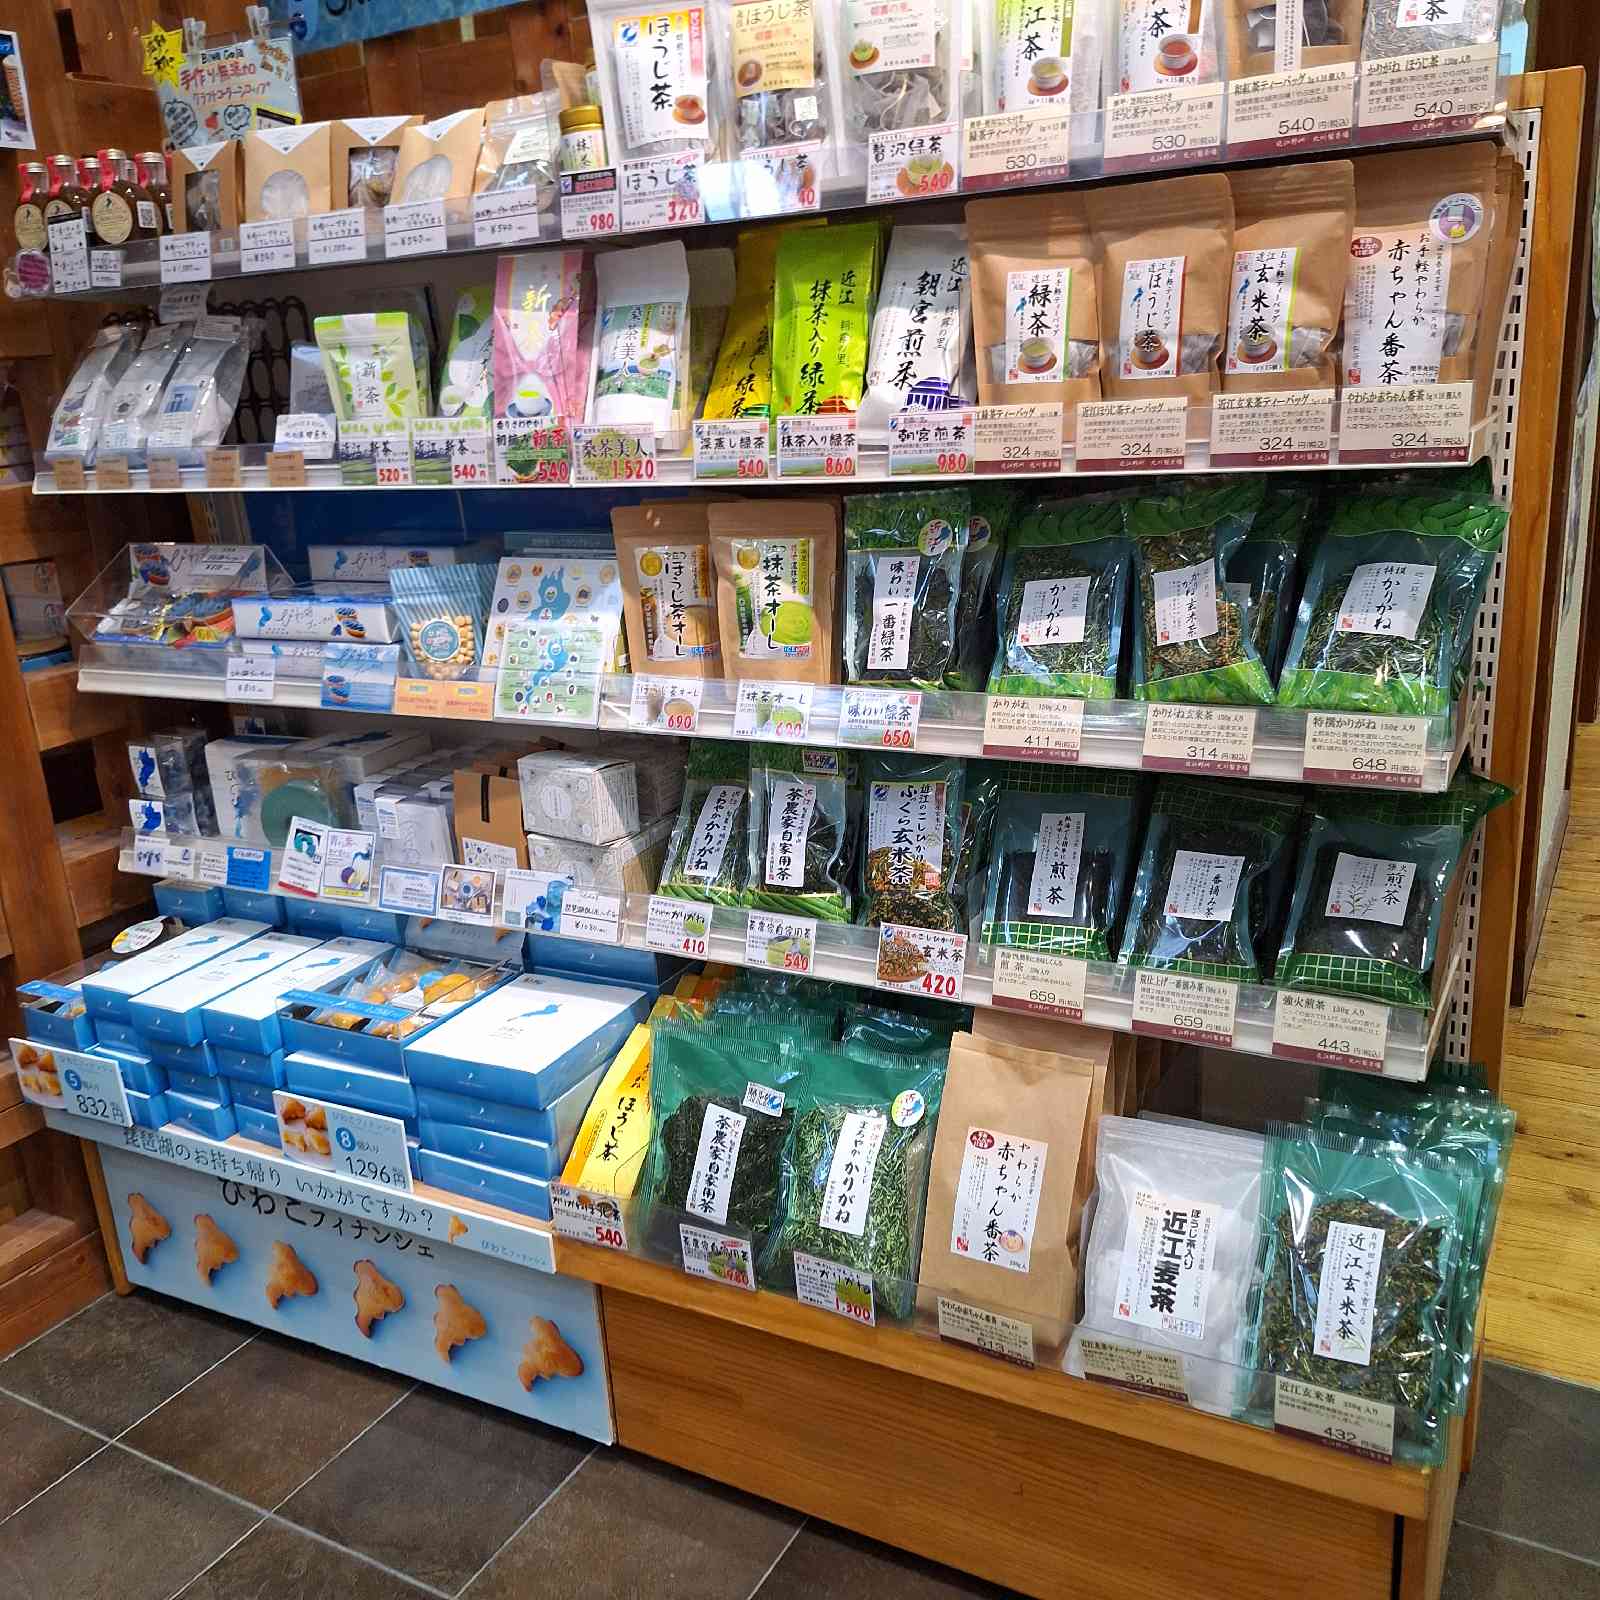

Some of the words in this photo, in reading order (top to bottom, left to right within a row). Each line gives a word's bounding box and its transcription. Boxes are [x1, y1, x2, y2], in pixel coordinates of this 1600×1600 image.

[648, 17, 673, 111] ほうじ茶
[1414, 99, 1453, 118] 540
[1278, 116, 1315, 135] 540
[872, 136, 943, 164] 贅沢緑茶
[1151, 134, 1186, 151] 530
[1006, 153, 1036, 170] 530
[626, 164, 697, 191] ほうじ茶
[919, 172, 950, 192] 540
[590, 212, 615, 231] 980
[667, 200, 699, 223] 320
[947, 256, 969, 293] 近江
[1411, 233, 1431, 326] お手軽やわらか
[838, 270, 857, 305] 近江
[1027, 284, 1053, 338] 緑茶
[1145, 272, 1163, 353] ほうじ茶
[1247, 263, 1274, 341] 玄米茶
[1377, 239, 1412, 385] 赤ちゃん番茶
[887, 271, 942, 390] 朝宮煎茶
[797, 280, 832, 415] 抹茶入り緑茶
[360, 360, 380, 405] 新茶
[532, 428, 567, 449] 新茶
[700, 436, 766, 450] 深蒸し緑茶
[781, 432, 857, 449] 抹茶入り緑茶
[898, 426, 967, 442] 朝宮煎茶
[1260, 436, 1294, 451] 324
[1391, 433, 1427, 448] 324
[582, 438, 649, 458] 桑茶美人
[1002, 445, 1031, 459] 324
[1120, 442, 1152, 457] 324
[454, 464, 477, 480] 540
[537, 460, 569, 482] 540
[737, 458, 765, 476] 540
[823, 455, 856, 476] 860
[936, 453, 967, 473] 980
[378, 468, 400, 482] 520
[880, 560, 905, 663] 味わい一番緑茶
[1045, 583, 1067, 640] かりがね
[1374, 577, 1401, 631] かりがね
[847, 703, 913, 722] 味わい緑茶
[992, 699, 1030, 710] かりがね
[1152, 708, 1214, 721] かりがね玄米茶
[667, 714, 693, 730] 690
[882, 728, 911, 747] 650
[1024, 734, 1051, 748] 411
[1186, 745, 1218, 759] 314
[1352, 756, 1388, 771] 648
[694, 789, 727, 871] さわやかかりがね
[775, 787, 804, 883] 茶農家自家用茶
[1046, 860, 1068, 905] 煎茶
[1205, 865, 1225, 918] 一番摘み茶
[1382, 872, 1406, 906] 煎茶
[682, 937, 706, 954] 410
[923, 944, 965, 963] 玄米茶
[784, 951, 810, 973] 540
[922, 973, 956, 996] 420
[1029, 989, 1056, 1004] 659
[1173, 1014, 1204, 1029] 659
[1318, 1038, 1351, 1054] 443
[77, 1094, 111, 1118] 832
[111, 1102, 126, 1124] 円
[340, 1130, 353, 1149] 8
[596, 1096, 637, 1162] ほうじ茶
[698, 1113, 734, 1214] 茶農家自家用茶
[835, 1120, 865, 1225] まろやかかりがね
[1011, 1142, 1031, 1204] やわらか
[122, 1127, 282, 1188] 琵琶湖のお持ち帰り
[295, 1175, 434, 1233] いかがですか?
[982, 1141, 1016, 1263] 赤ちゃん番茶
[595, 1226, 623, 1247] 540
[1184, 1208, 1201, 1270] ほうじ茶入り
[1150, 1209, 1188, 1314] 近江麦茶
[1336, 1232, 1367, 1340] 近江玄米茶
[1323, 1426, 1357, 1443] 432
